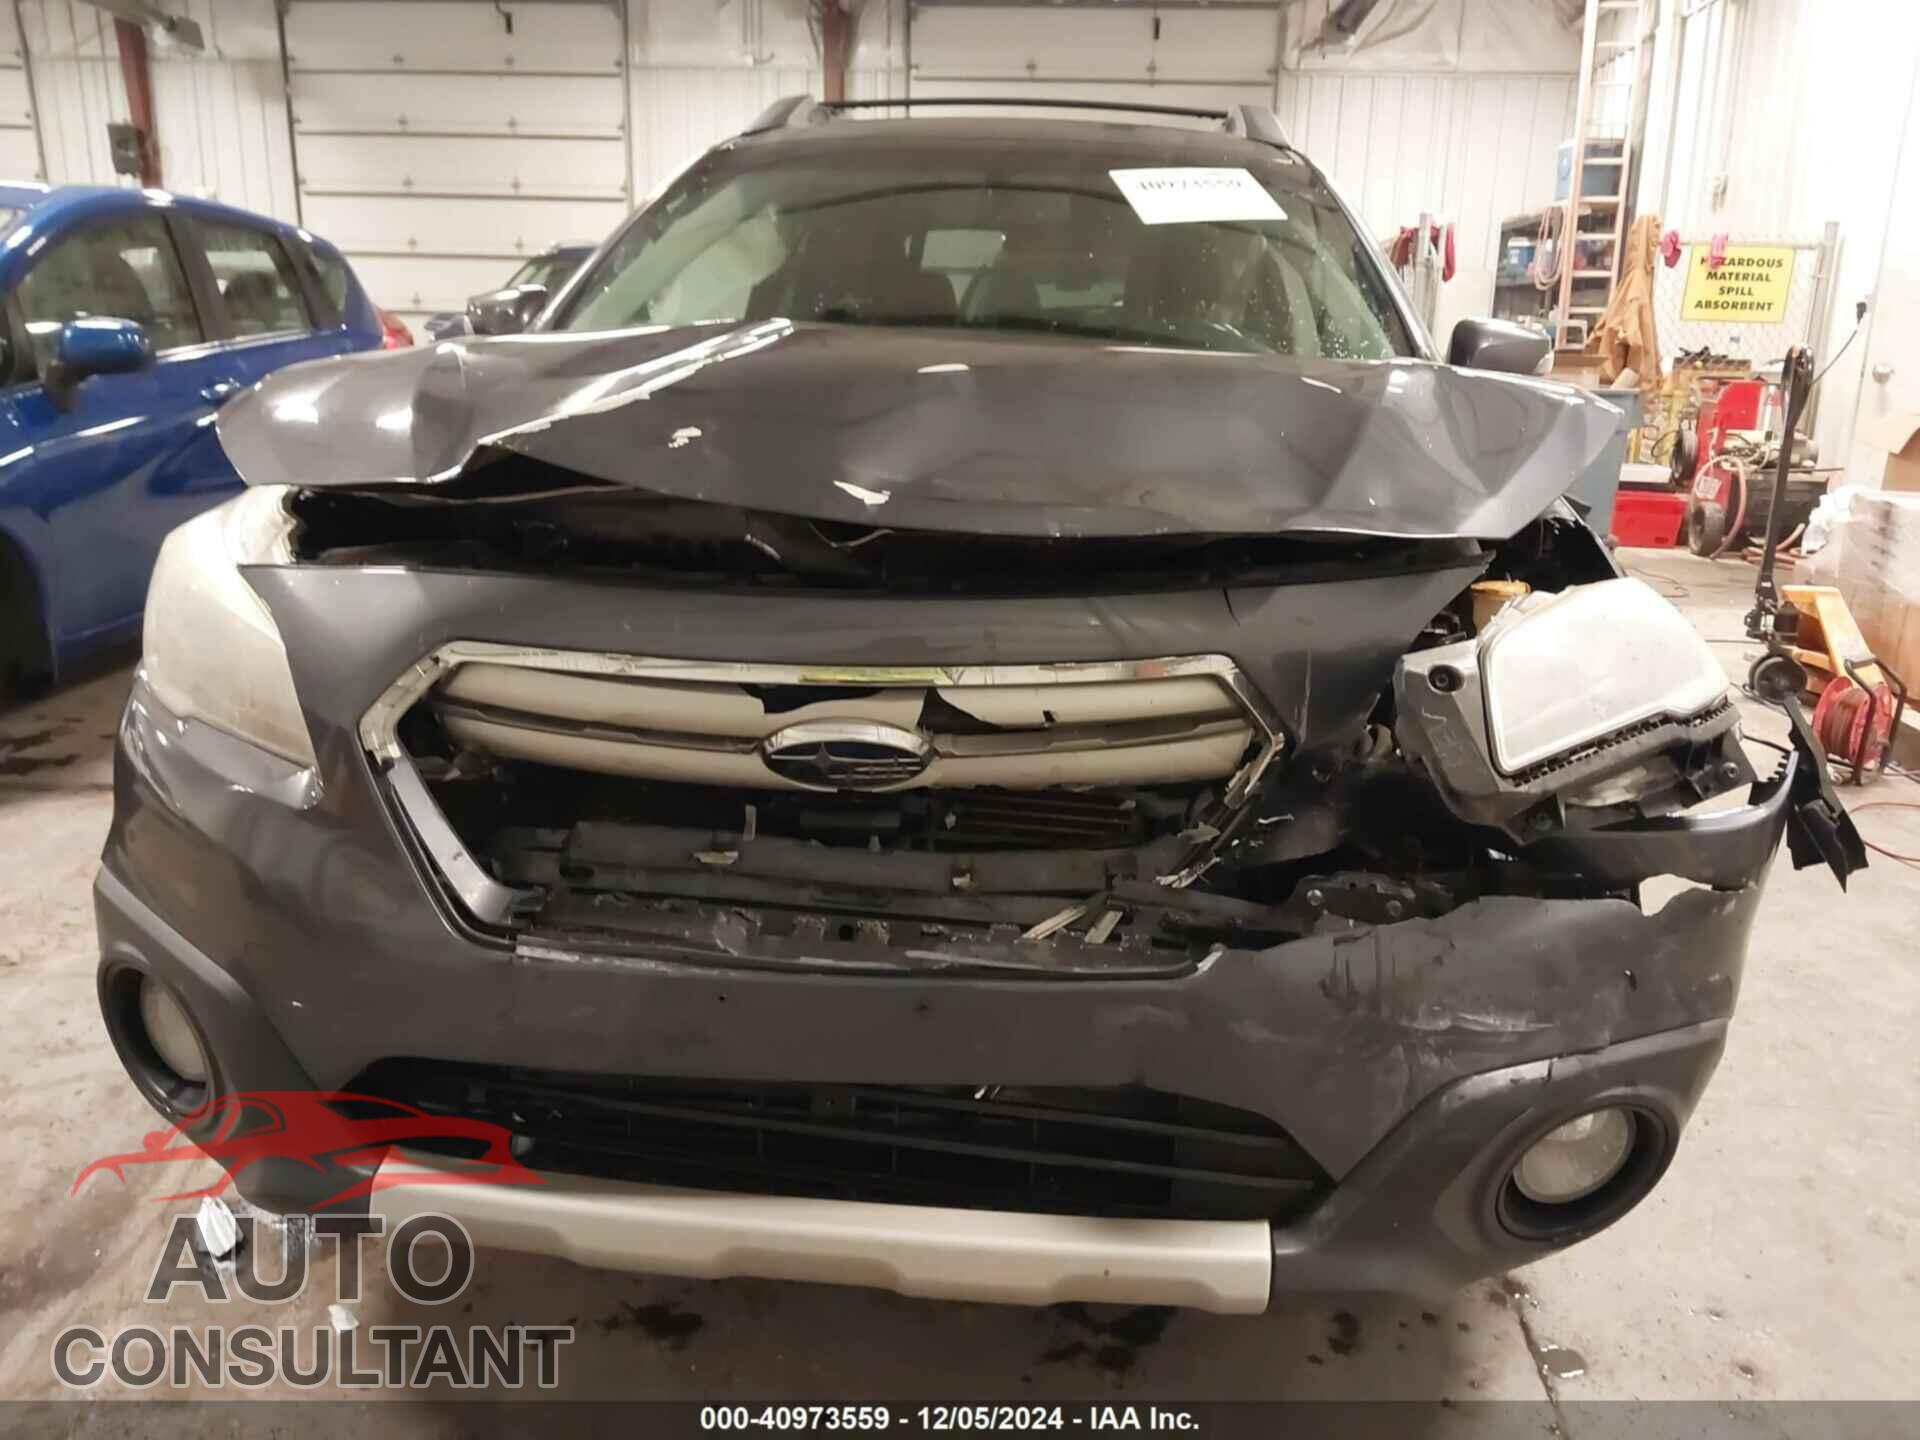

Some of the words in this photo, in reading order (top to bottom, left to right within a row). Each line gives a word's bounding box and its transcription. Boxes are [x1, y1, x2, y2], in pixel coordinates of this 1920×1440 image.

[1700, 256, 1783, 268] HZARDOUS
[1706, 271, 1772, 282] MATERIAL
[1718, 286, 1754, 296] SPILL
[1694, 300, 1774, 311] ABSORBENT
